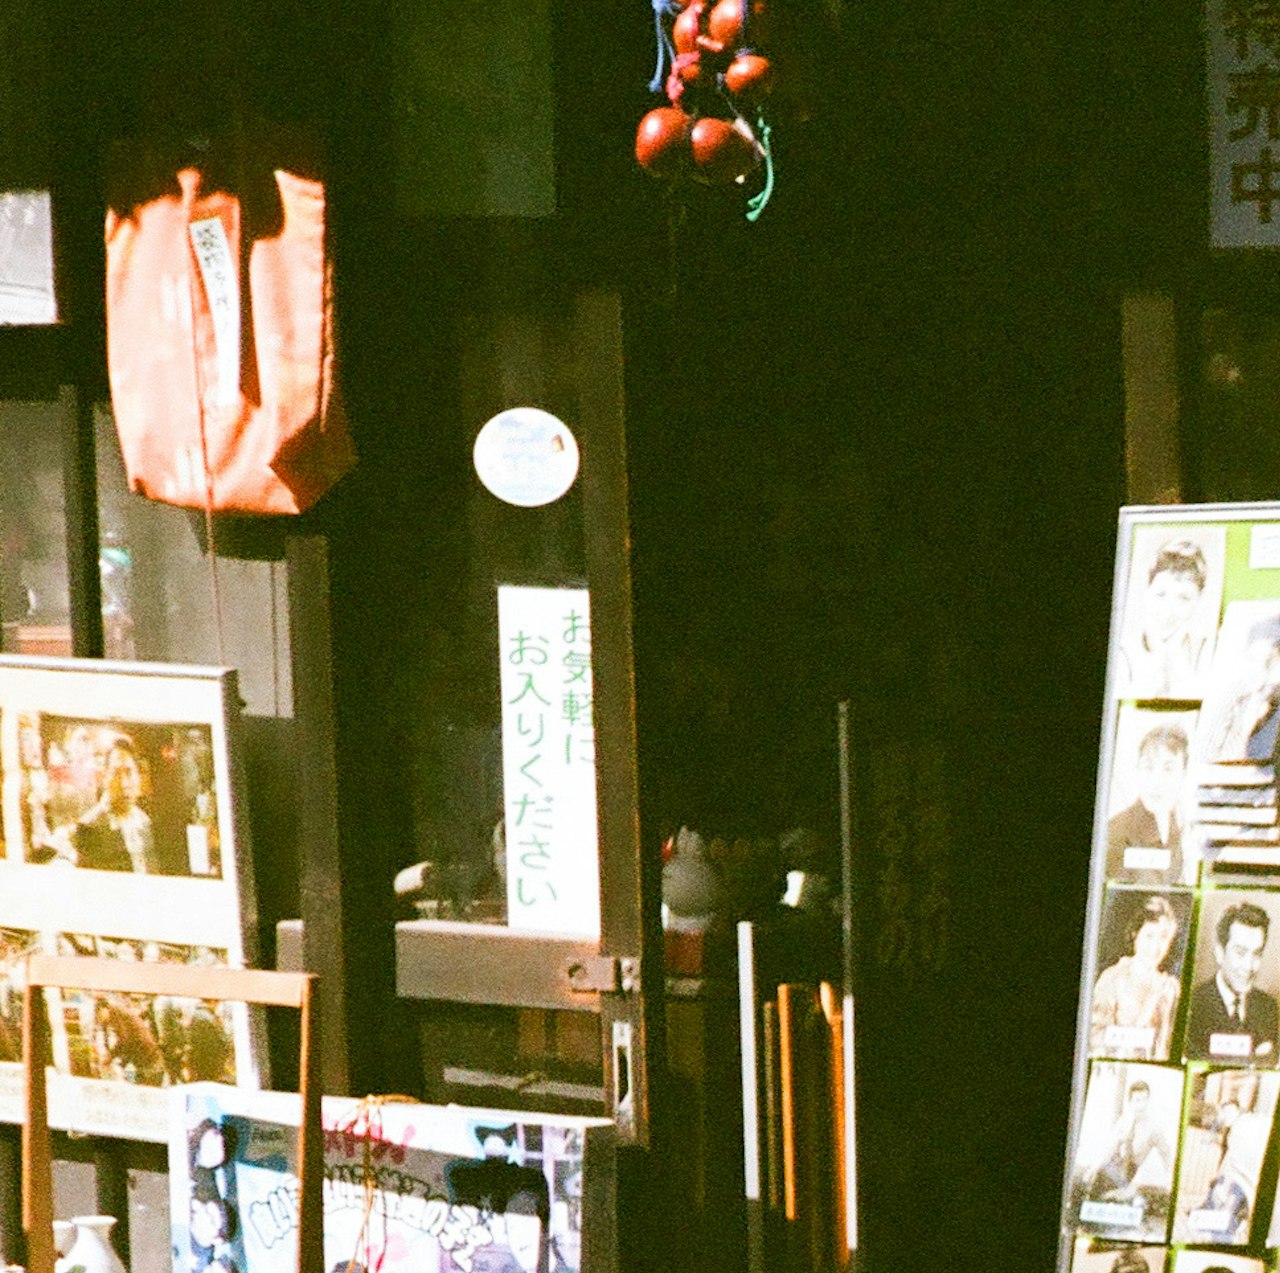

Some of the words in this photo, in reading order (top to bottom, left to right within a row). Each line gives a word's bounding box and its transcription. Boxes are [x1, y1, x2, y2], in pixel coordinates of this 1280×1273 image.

[508, 629, 558, 907] お入りください
[561, 608, 595, 766] お気軽に
